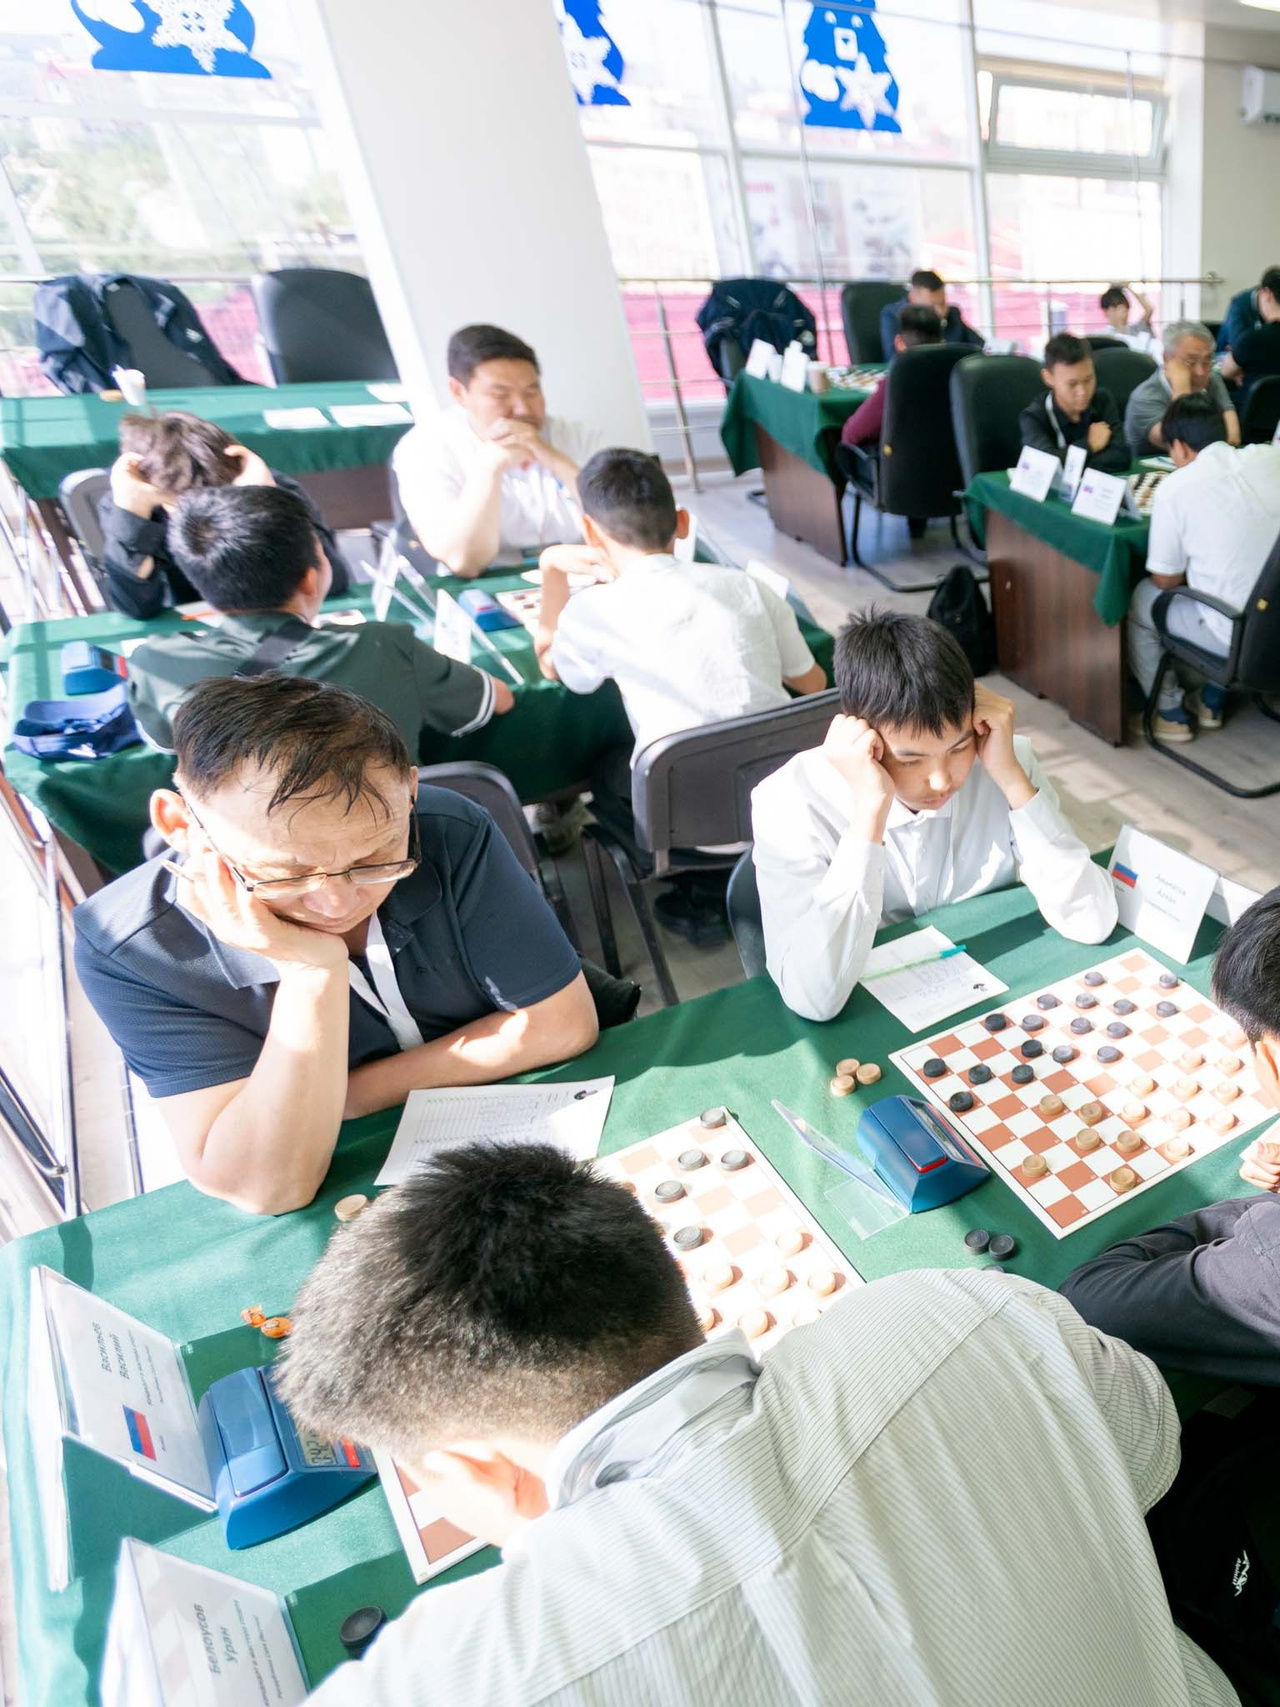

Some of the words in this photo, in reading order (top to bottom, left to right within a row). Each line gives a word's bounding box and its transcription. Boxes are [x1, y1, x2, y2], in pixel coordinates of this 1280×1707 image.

[92, 1320, 112, 1373] Васильев
[109, 1333, 130, 1380] Василий
[194, 1603, 221, 1674] Белоусов
[220, 1626, 239, 1664] Уран
